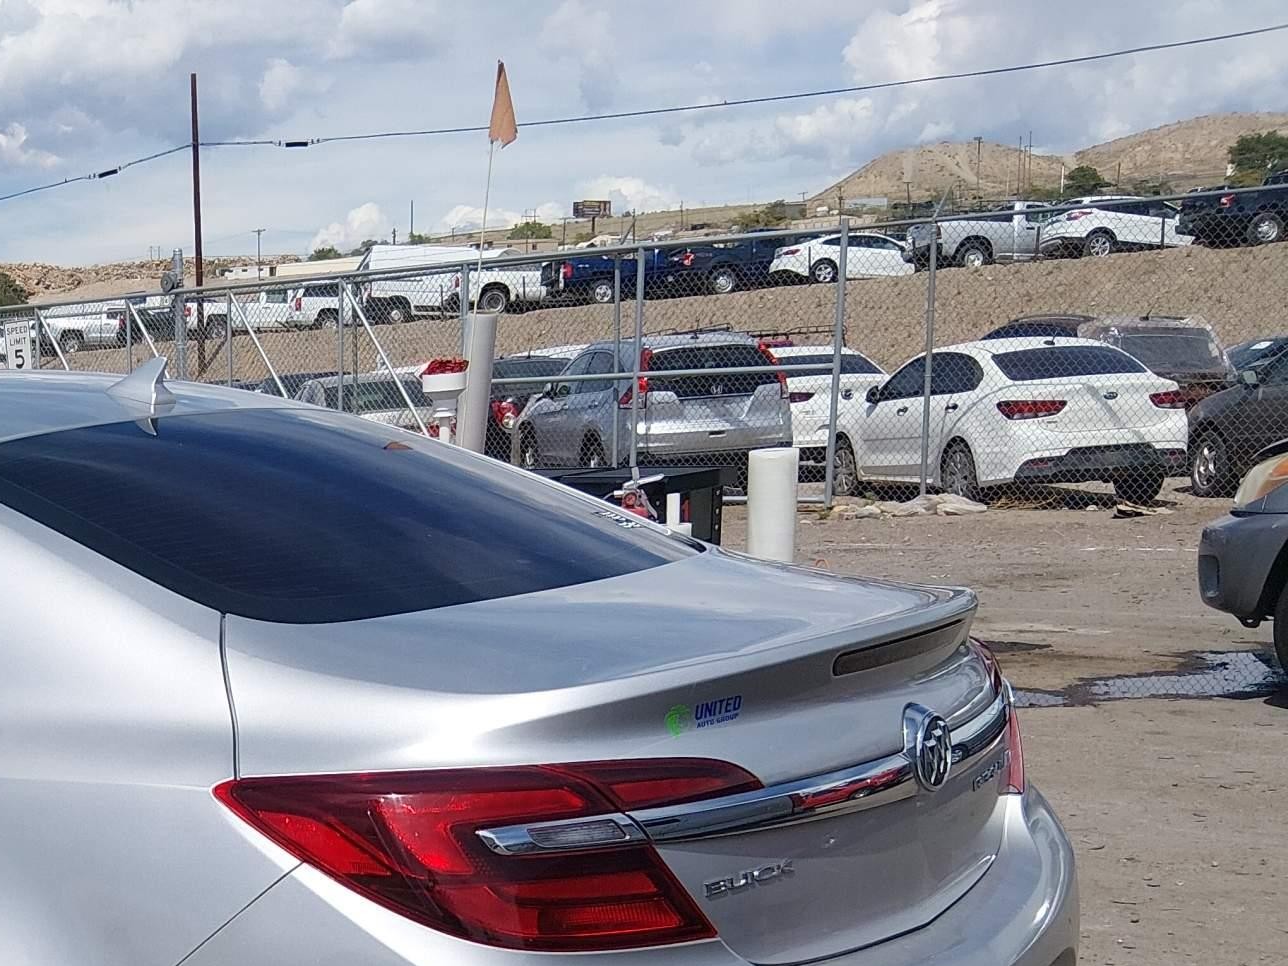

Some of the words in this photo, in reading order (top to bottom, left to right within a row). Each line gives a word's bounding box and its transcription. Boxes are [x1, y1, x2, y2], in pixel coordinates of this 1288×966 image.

[6, 326, 28, 336] SPEED
[9, 337, 27, 346] LIMIT
[14, 349, 26, 370] 5
[694, 695, 743, 721] UNITED
[696, 718, 715, 729] AUTO
[716, 712, 740, 725] GROUP
[703, 858, 794, 899] BUICK
